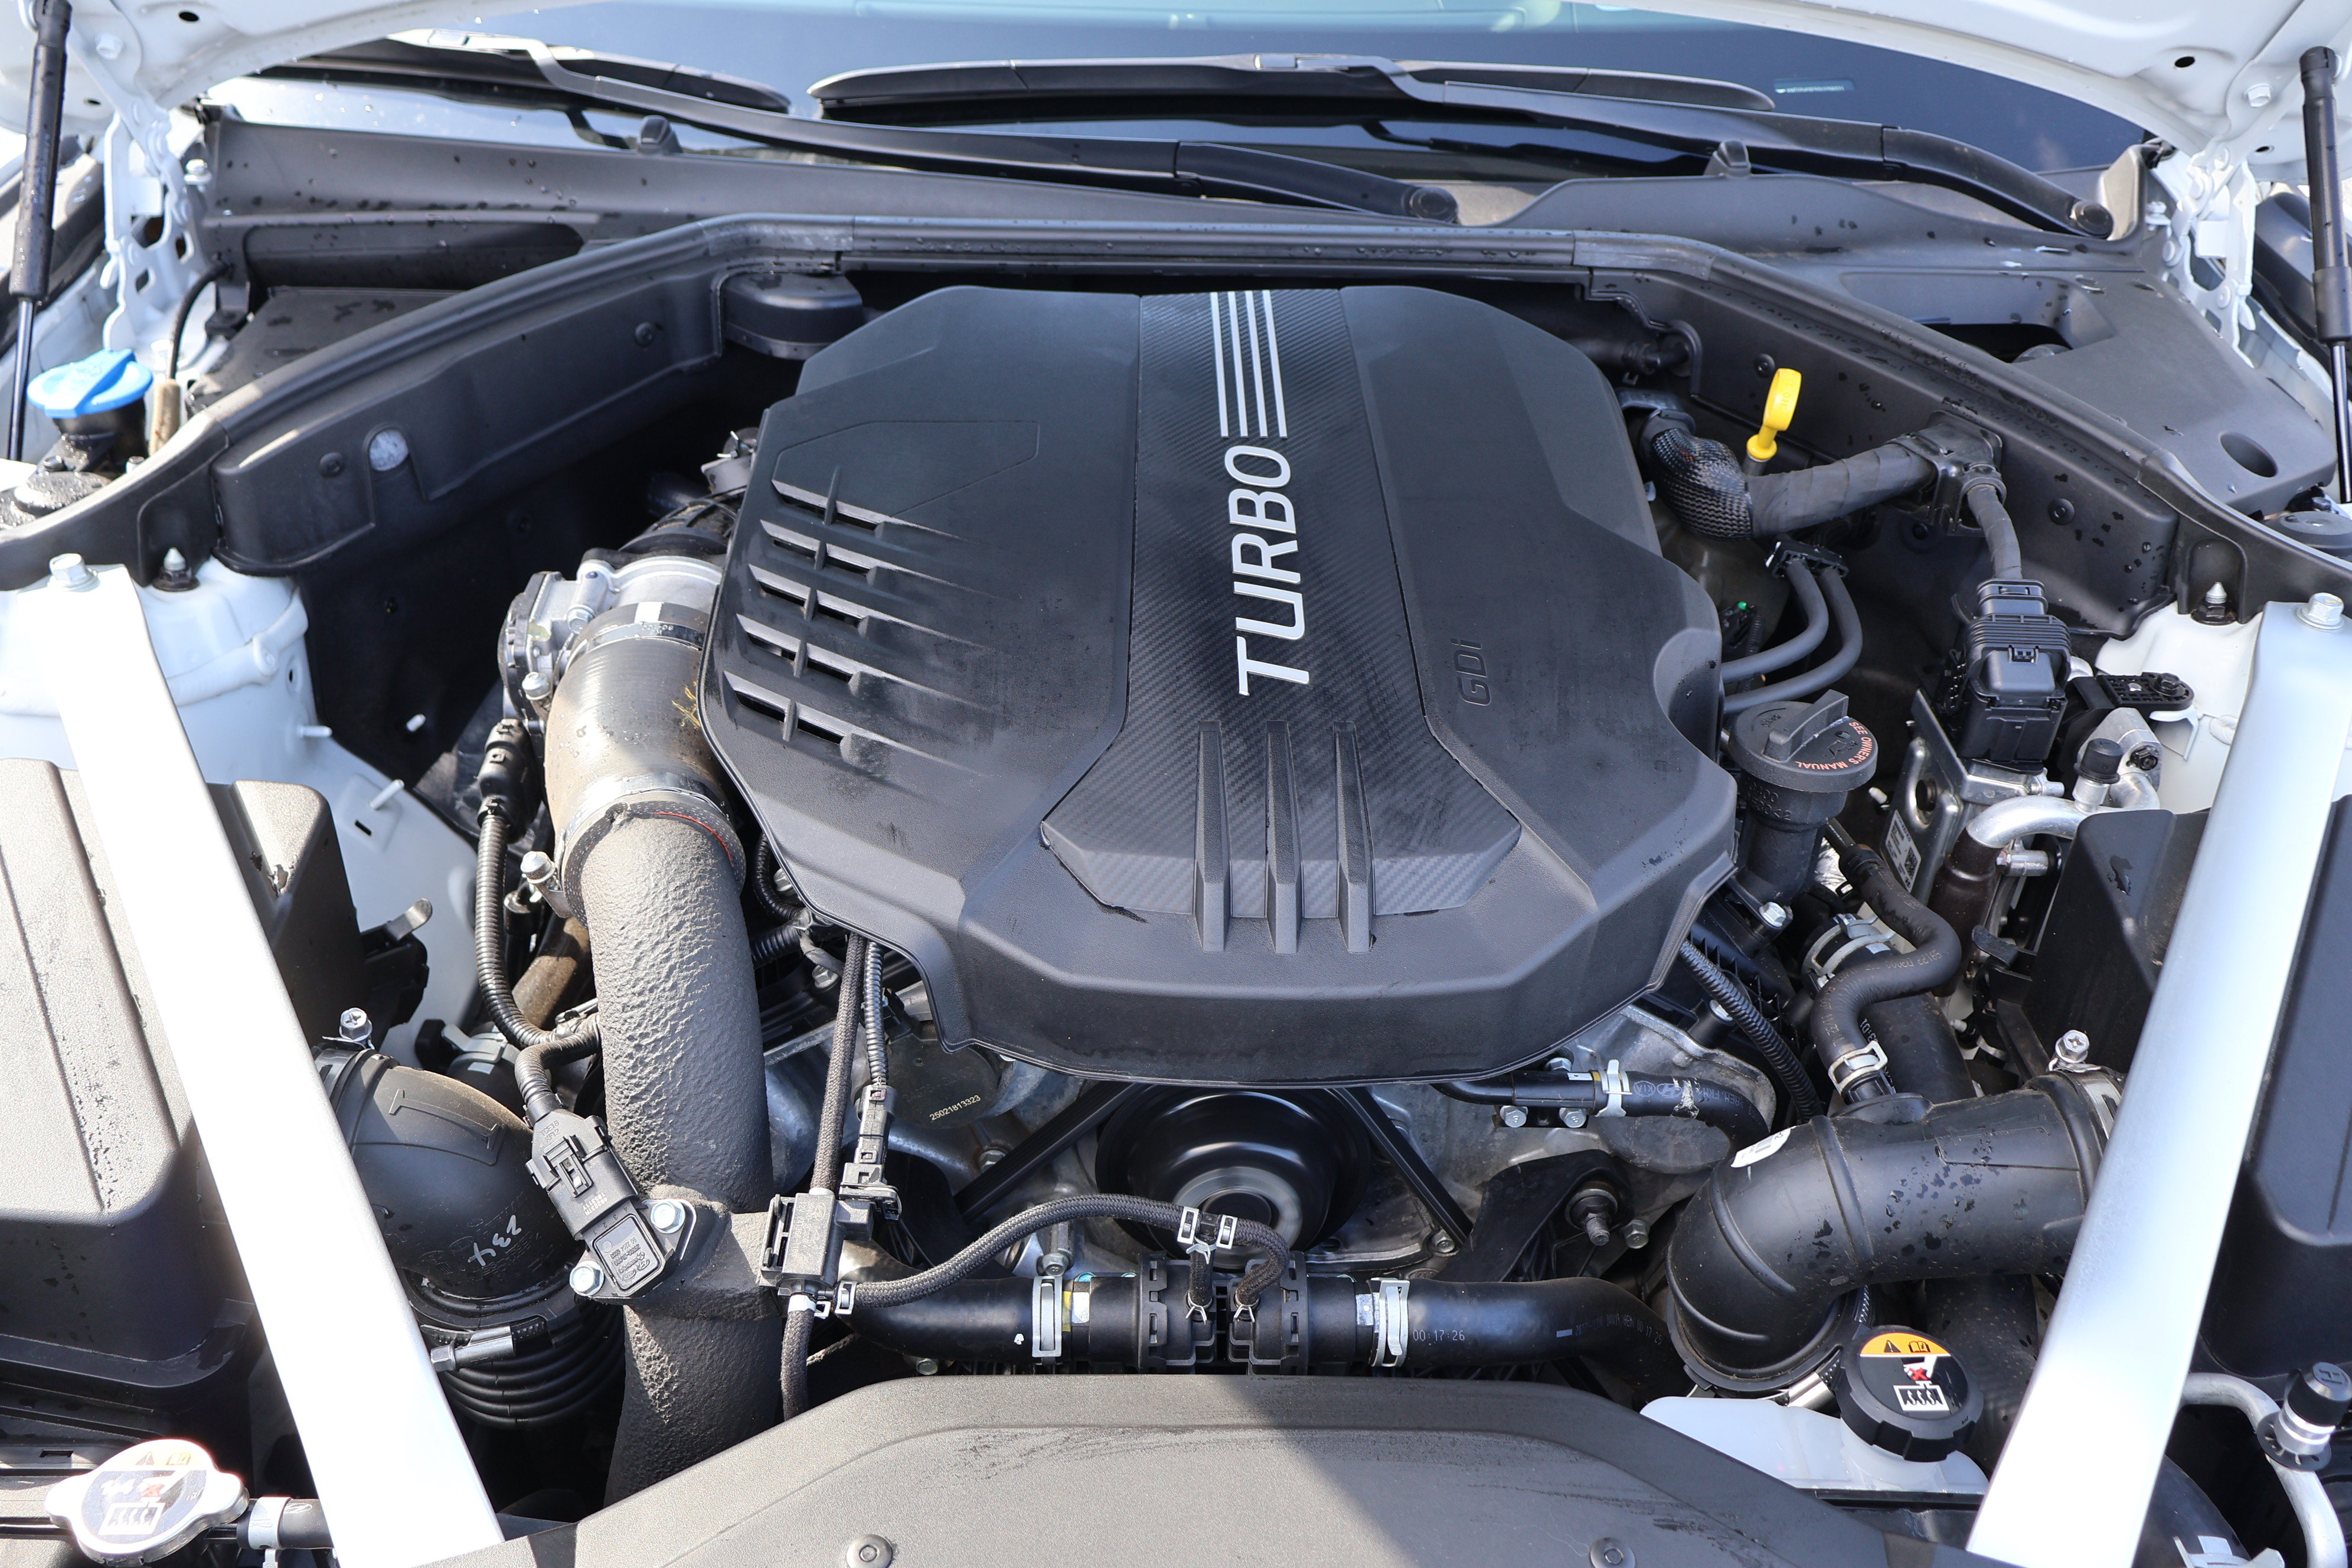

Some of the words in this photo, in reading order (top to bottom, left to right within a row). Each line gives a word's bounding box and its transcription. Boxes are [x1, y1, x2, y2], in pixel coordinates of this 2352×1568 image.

[1224, 445, 1310, 697] TURBO
[1450, 638, 1491, 707] GDi
[1848, 721, 1868, 735] SEE
[1848, 736, 1874, 765] OWNER'S
[1794, 760, 1850, 770] MANUAL
[929, 1095, 981, 1121] 25021813323
[1412, 1329, 1465, 1342] 00:17:26
